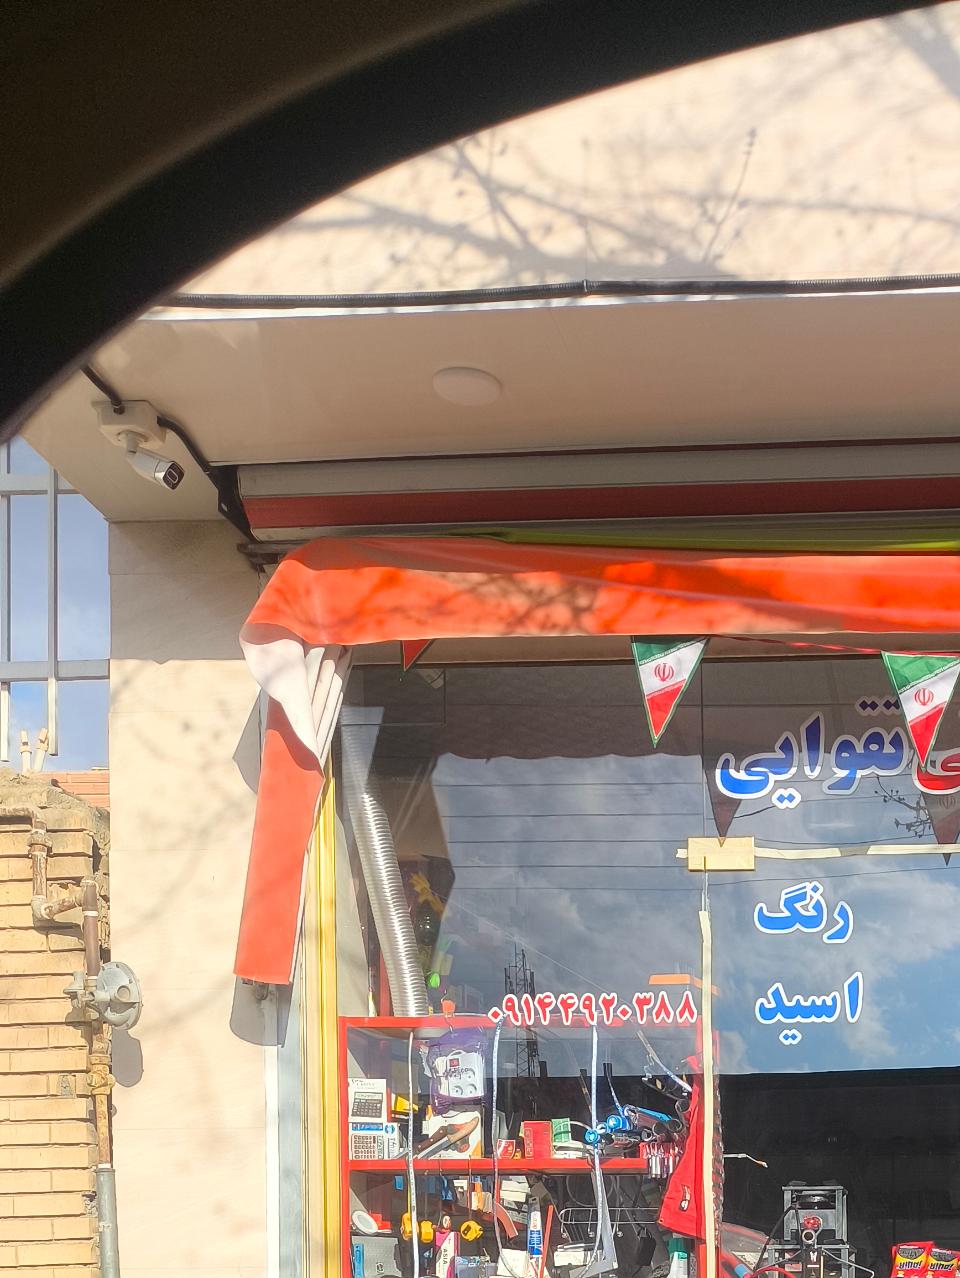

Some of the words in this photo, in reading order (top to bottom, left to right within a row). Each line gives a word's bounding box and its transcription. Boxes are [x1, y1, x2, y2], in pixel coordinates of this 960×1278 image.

[753, 881, 854, 944] رنگ
[487, 990, 699, 1026] ۰۹۱۴۴۹۲۰۳۸۸
[754, 971, 864, 1046] اسید
